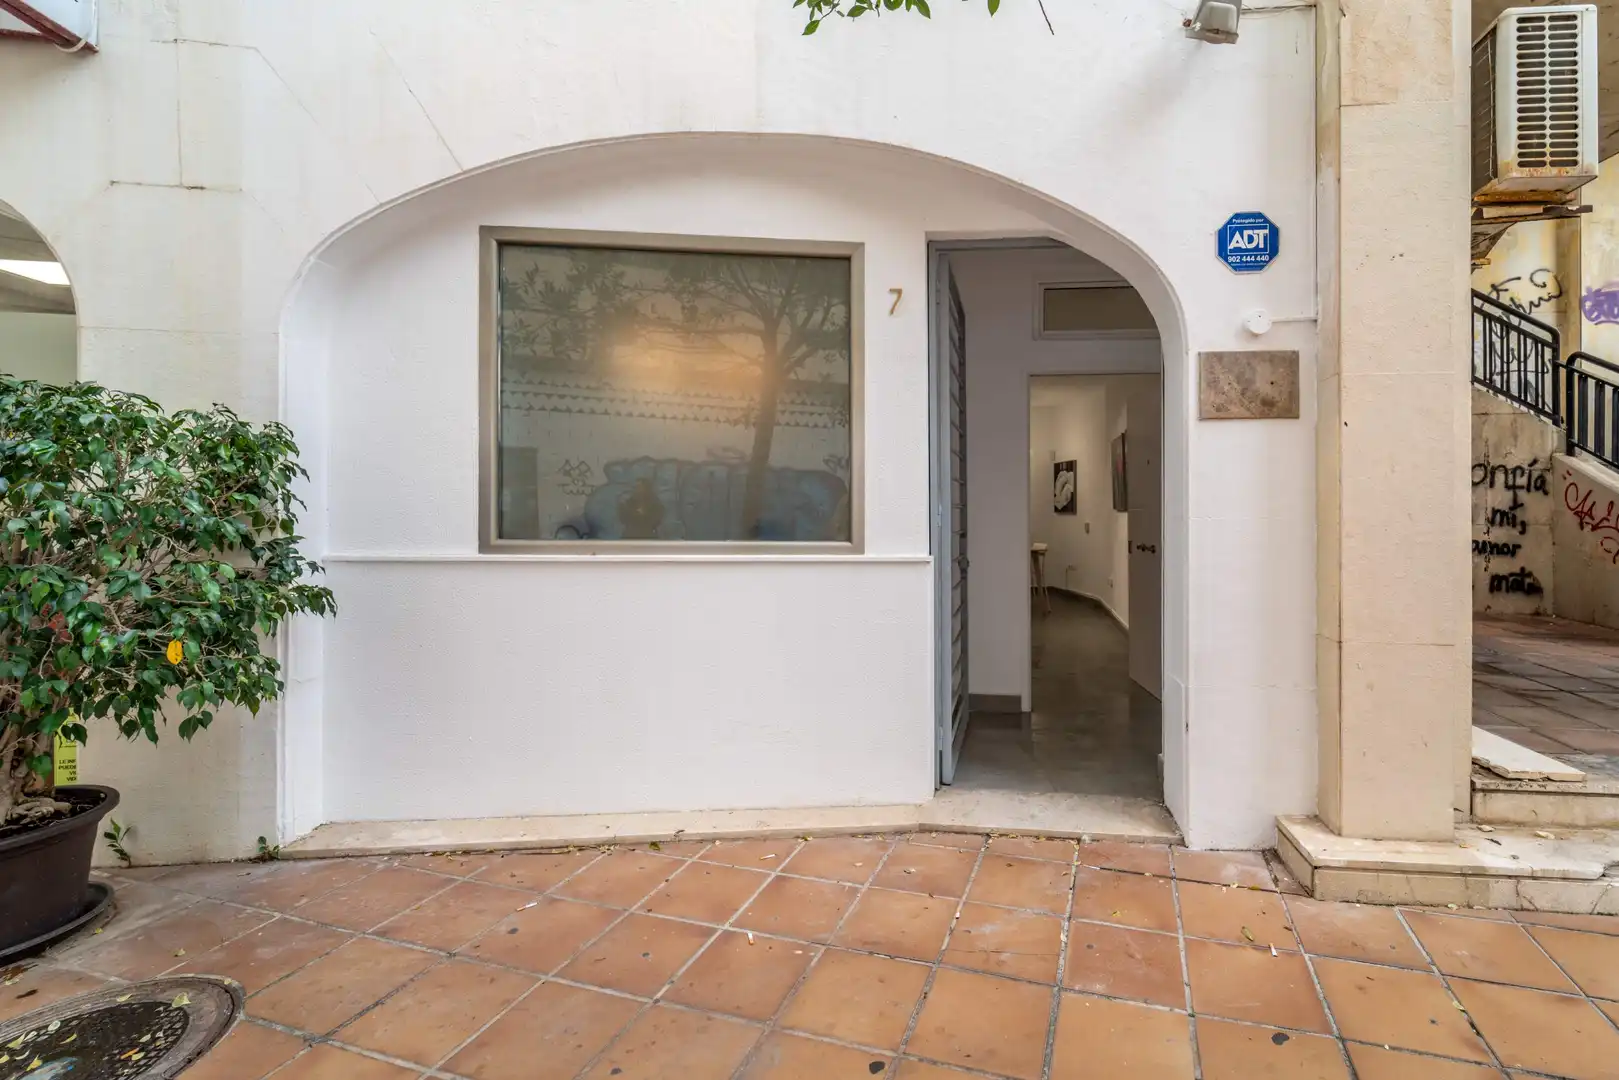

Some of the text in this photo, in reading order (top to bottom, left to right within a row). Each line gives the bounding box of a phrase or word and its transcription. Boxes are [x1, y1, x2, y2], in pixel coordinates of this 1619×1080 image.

[1228, 229, 1268, 249] ADT
[889, 288, 902, 316] 7
[1472, 458, 1549, 507] onfía
